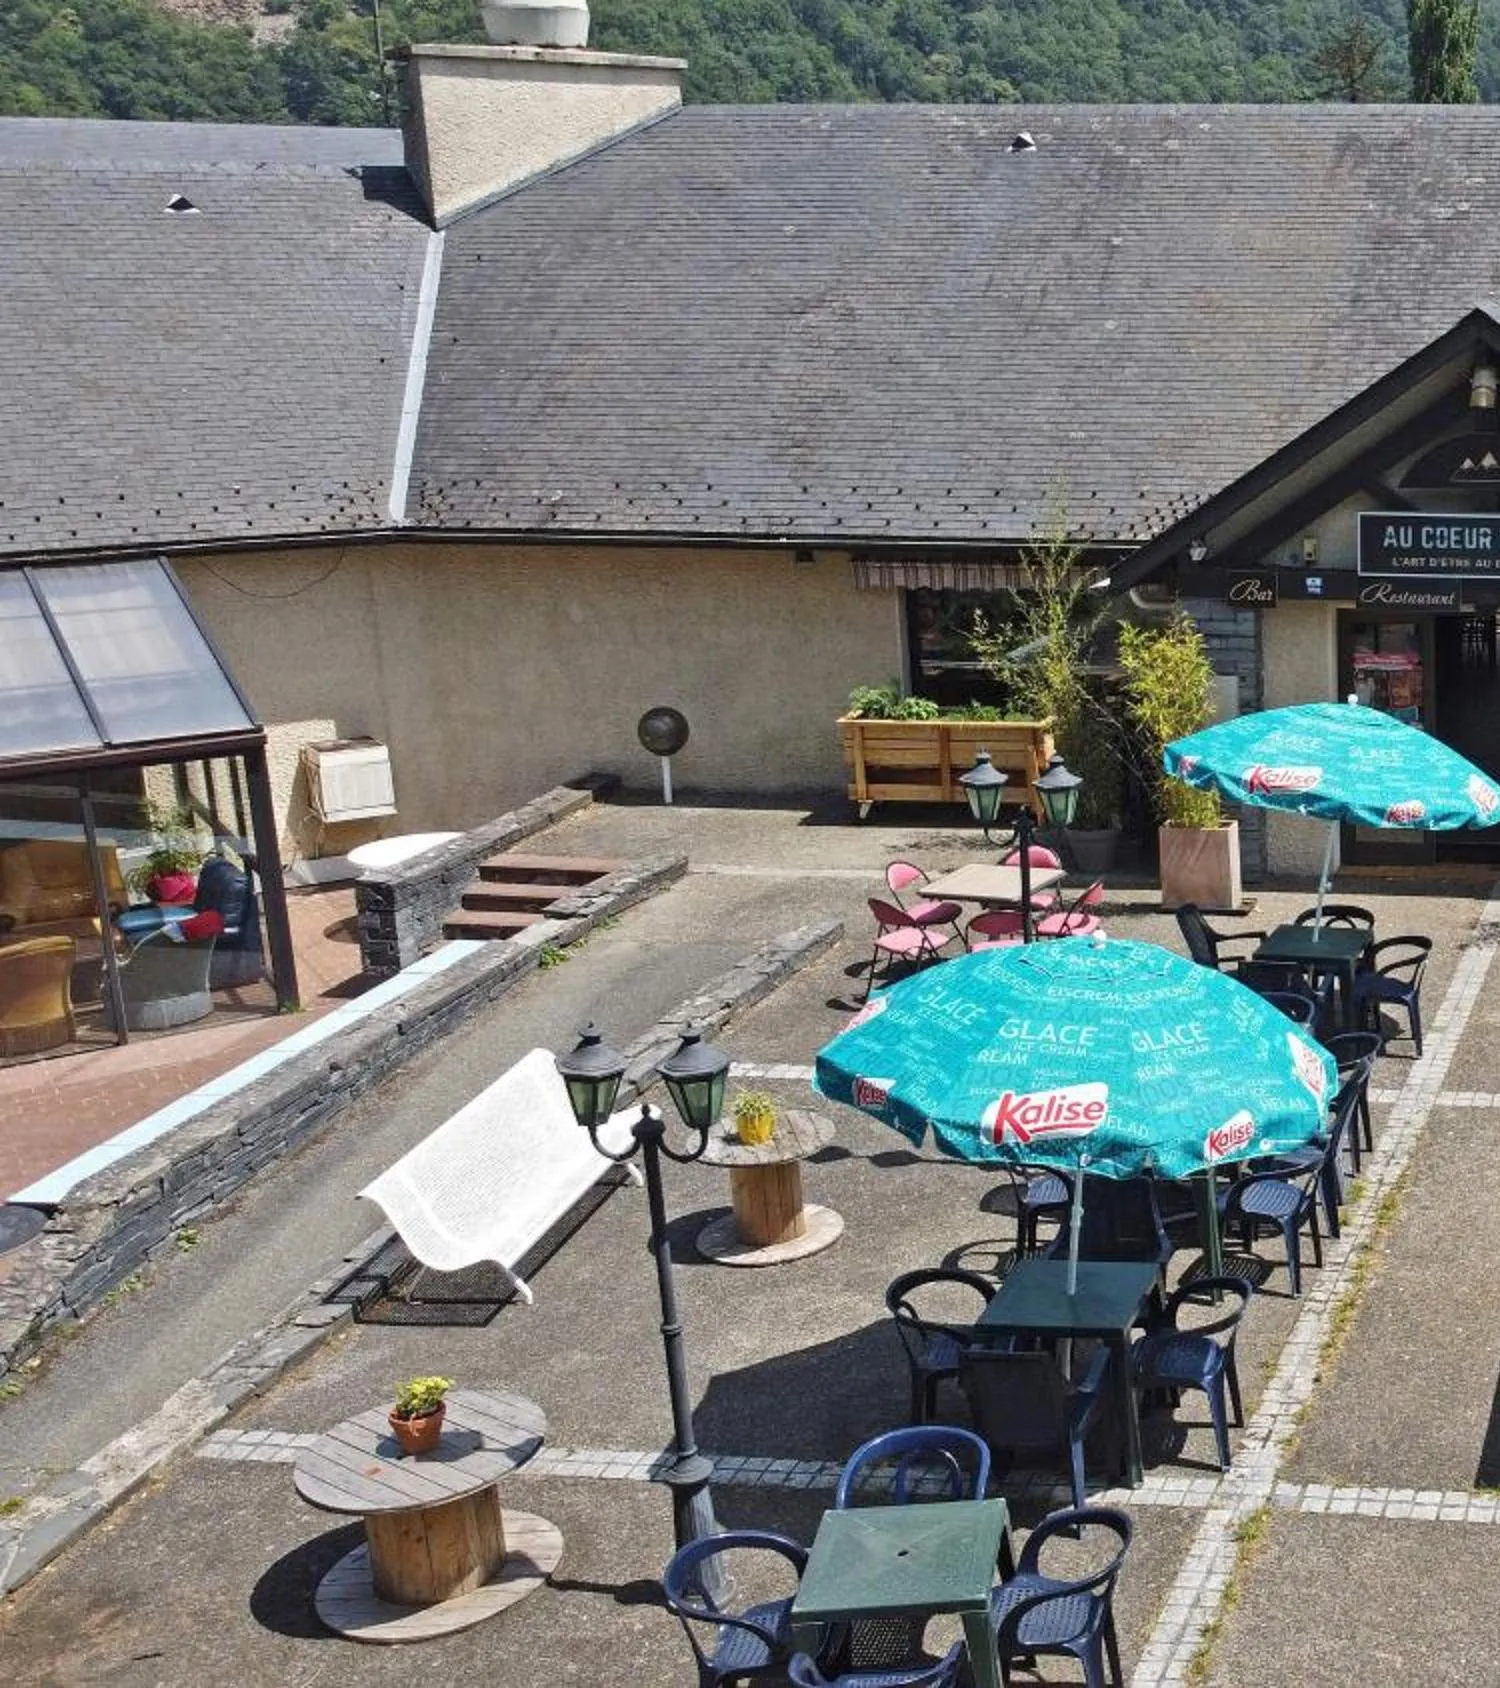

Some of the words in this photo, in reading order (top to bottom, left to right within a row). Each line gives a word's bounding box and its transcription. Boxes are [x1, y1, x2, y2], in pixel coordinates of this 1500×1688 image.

[1383, 525, 1413, 548] AU
[1421, 526, 1492, 550] COEUR
[1475, 558, 1492, 569] AU
[1229, 579, 1273, 601] Bar
[1360, 582, 1455, 606] Restaurant
[1247, 765, 1318, 795] Kalise
[999, 1018, 1099, 1046] GLACE
[1131, 1021, 1210, 1052] GLACE
[1039, 1043, 1088, 1058] CREAM
[993, 1092, 1106, 1144] Kalise
[1208, 1121, 1253, 1157] Kalise
